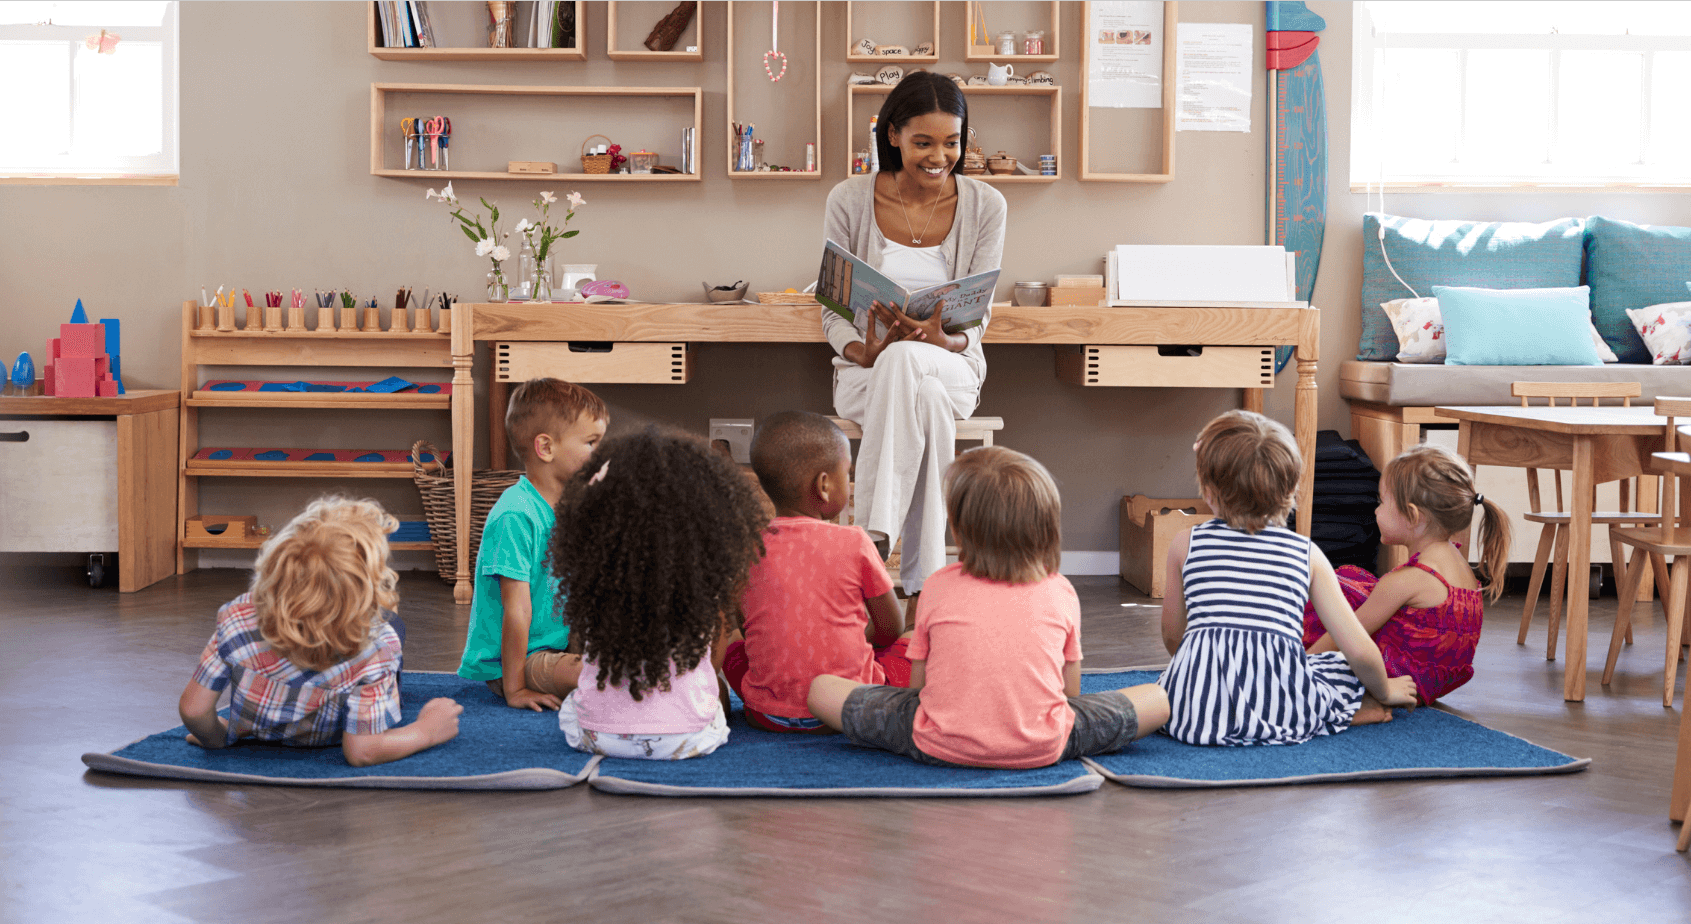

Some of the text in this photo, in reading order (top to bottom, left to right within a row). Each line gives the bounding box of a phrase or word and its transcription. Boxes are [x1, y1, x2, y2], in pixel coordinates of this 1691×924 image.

[861, 39, 876, 55] Joy
[881, 48, 902, 56] space
[960, 288, 988, 298] Daddy
[941, 294, 985, 312] GIANT
